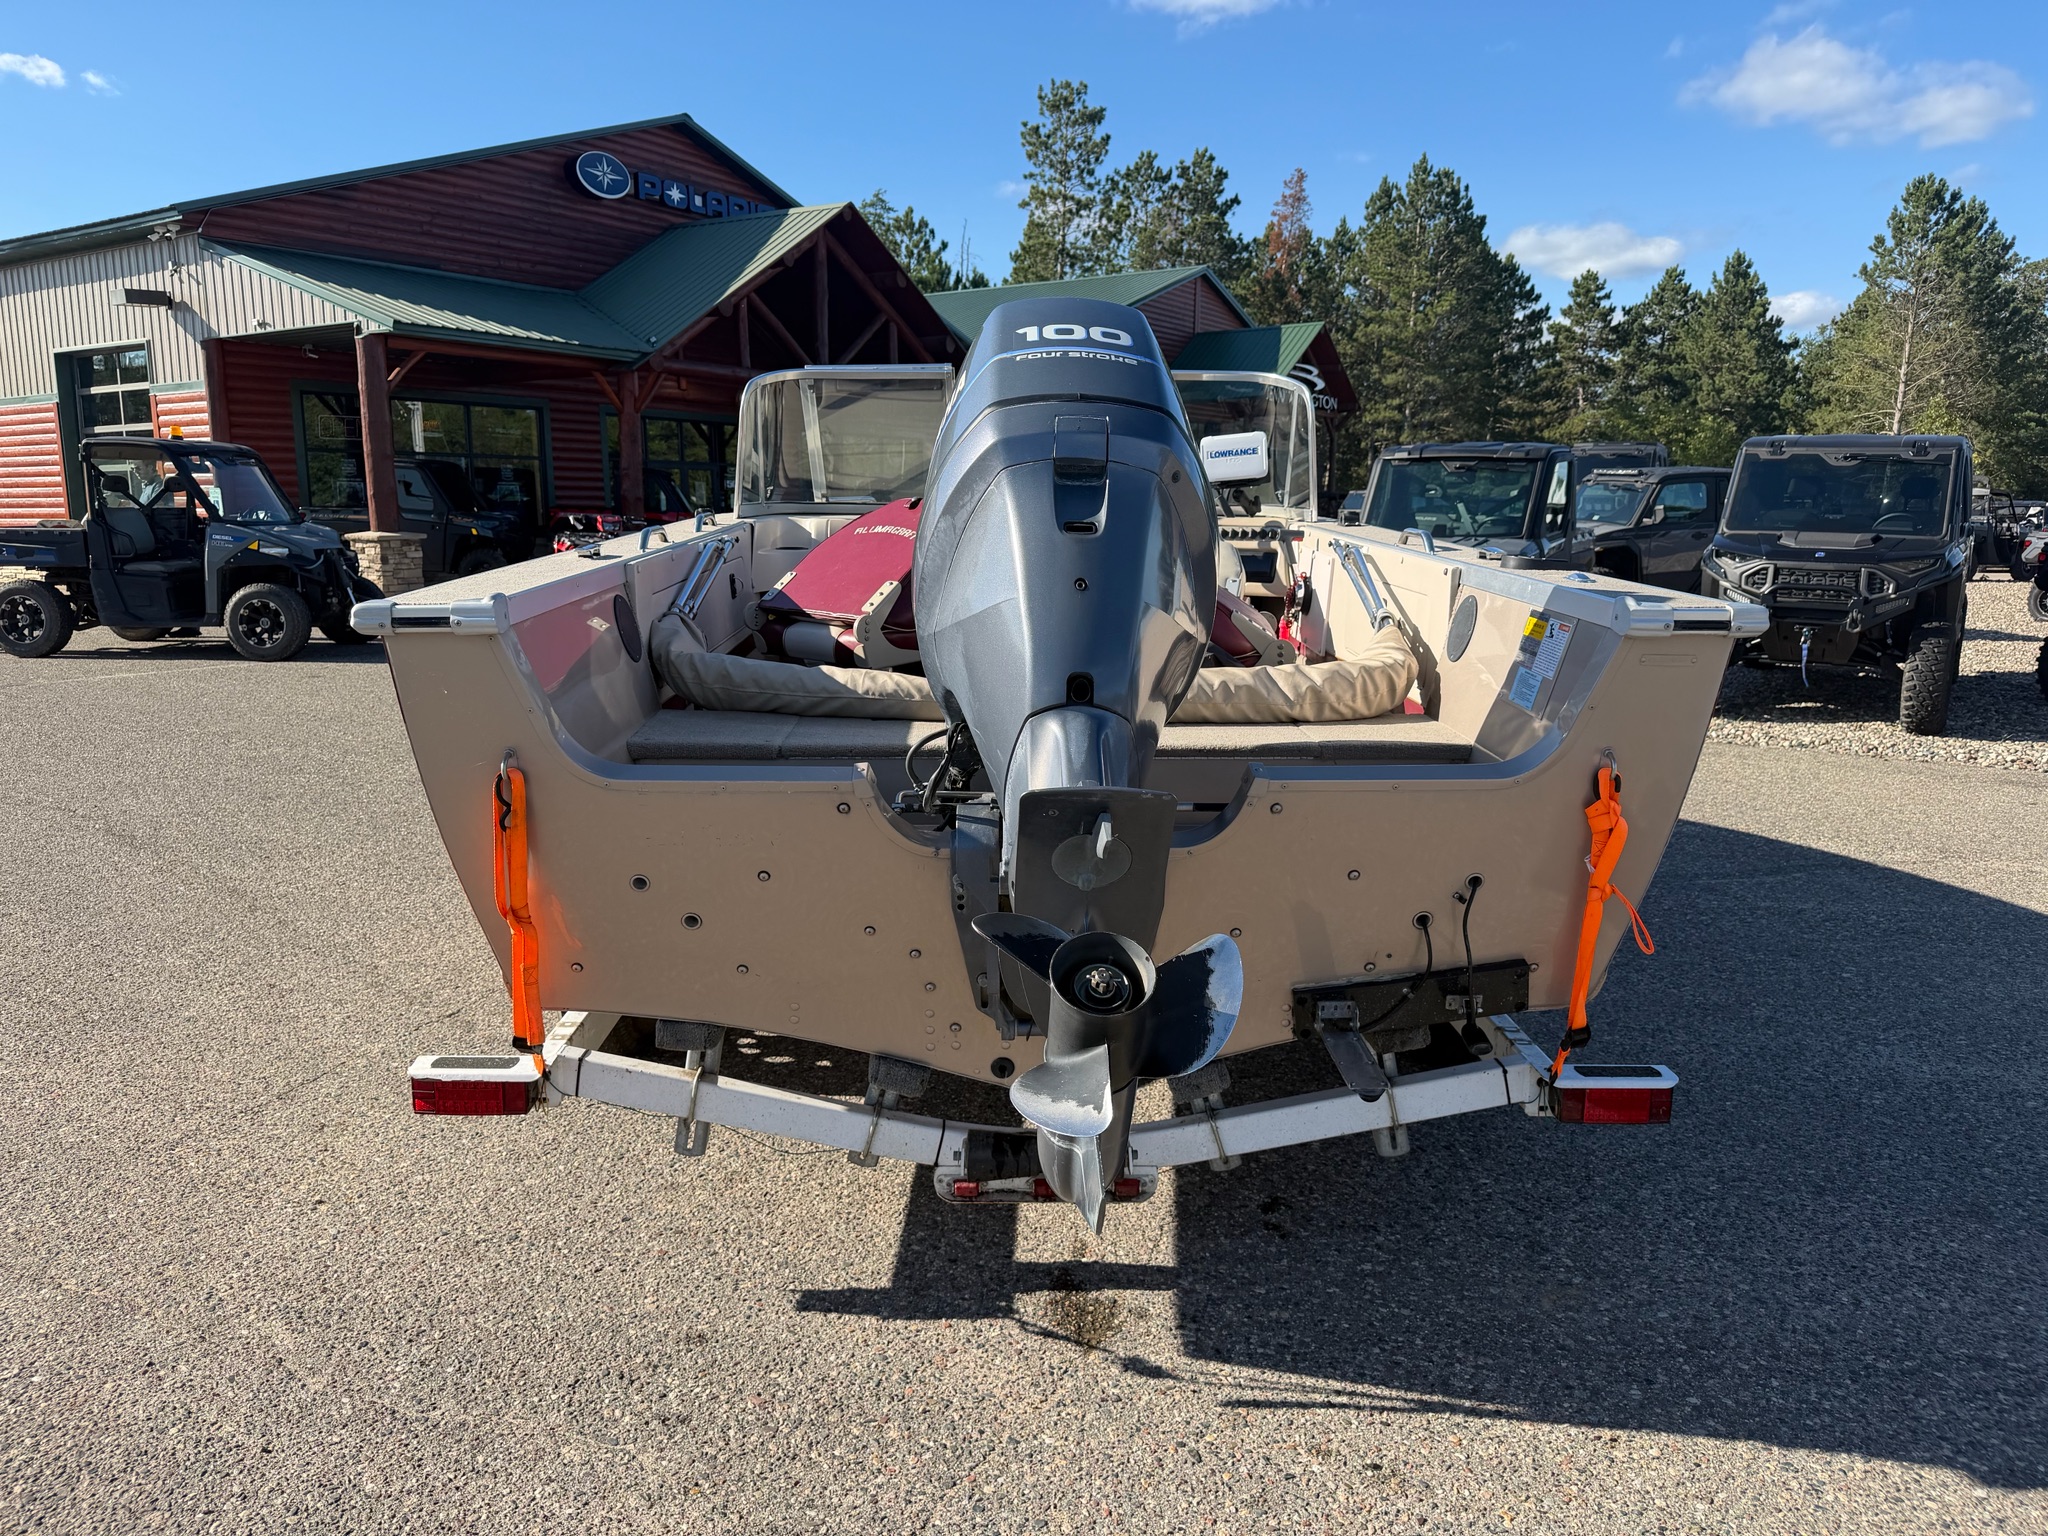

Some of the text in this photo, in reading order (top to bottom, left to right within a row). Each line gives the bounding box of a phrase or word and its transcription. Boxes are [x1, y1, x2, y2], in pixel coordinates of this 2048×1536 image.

[1015, 323, 1134, 347] 100
[1209, 446, 1259, 459] LOWRANCE
[854, 525, 918, 540] ALUMACRAF
[1778, 574, 1857, 588] POLARIS
